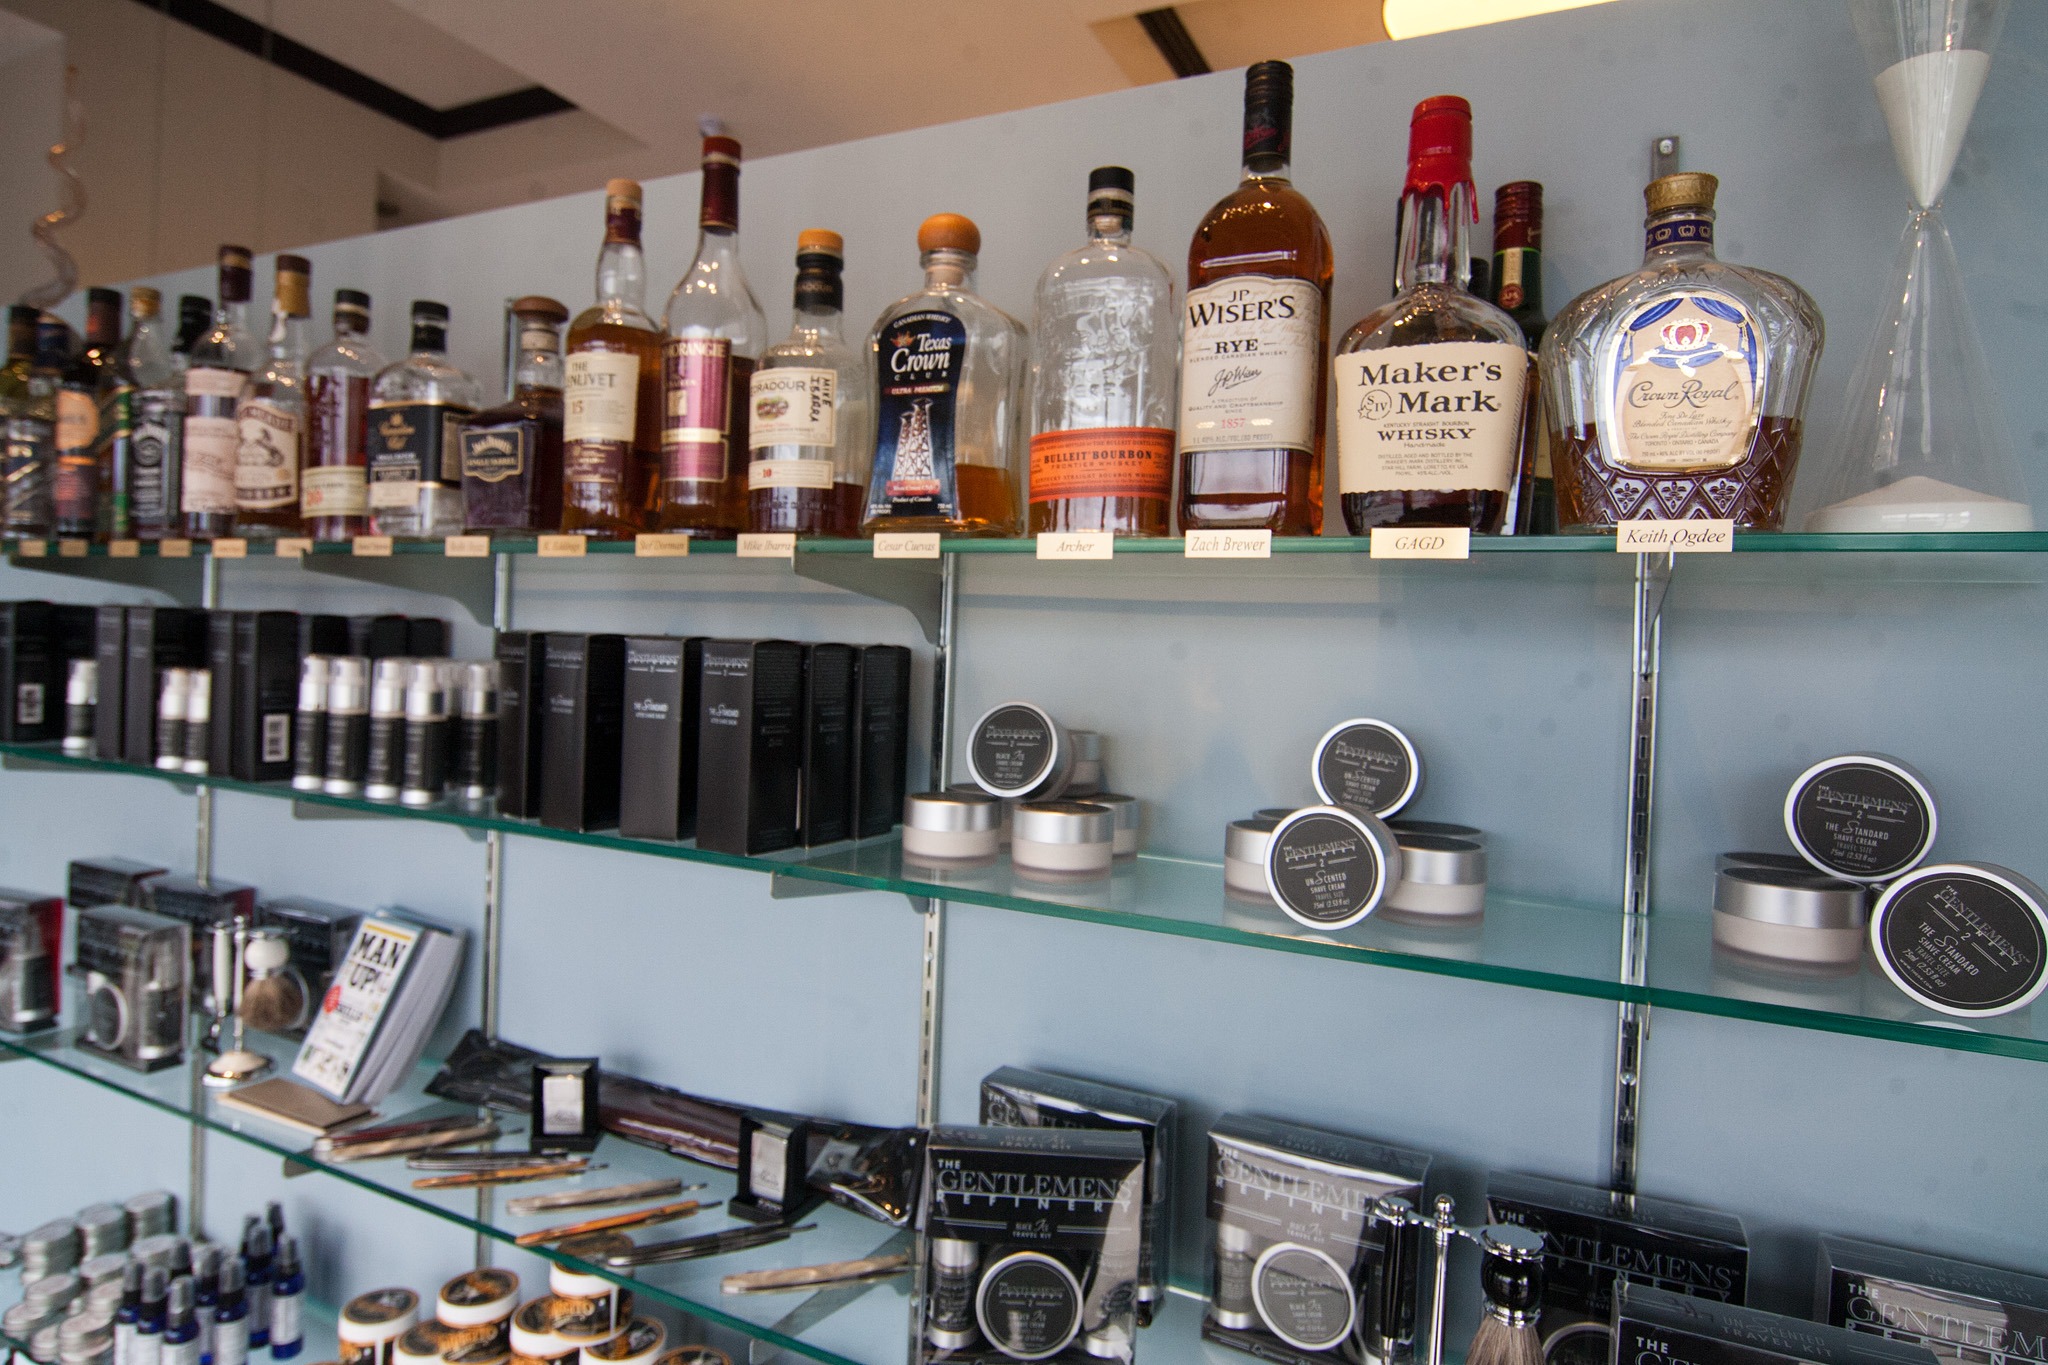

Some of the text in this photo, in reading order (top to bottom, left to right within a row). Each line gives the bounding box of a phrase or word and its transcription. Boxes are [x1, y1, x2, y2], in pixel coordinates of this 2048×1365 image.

[1228, 290, 1250, 302] JP
[1189, 295, 1295, 328] WISER'S
[917, 333, 952, 352] Texas
[1215, 339, 1259, 354] RYE
[891, 348, 950, 373] Crown
[1358, 361, 1502, 387] Maker's
[822, 378, 832, 408] MIKE
[1628, 380, 1739, 408] Crown Royal
[1396, 390, 1499, 415] Mark
[1221, 418, 1246, 429] 1857
[1377, 428, 1476, 442] WHISKY
[1044, 452, 1088, 464] BULLEIT
[1092, 450, 1152, 460] BOURBON
[878, 540, 936, 552] Cesar Cuevas
[1056, 540, 1095, 552] Archer
[1191, 537, 1266, 551] Zach Brewer
[1395, 536, 1445, 551] GAGD
[1626, 529, 1726, 545] Keith Ogdee
[1818, 789, 1909, 811] GENTLEMENS
[1857, 810, 1862, 819] 2
[1825, 820, 1889, 840] THE STANDARD
[1833, 833, 1877, 847] SHAVE CREAM
[1320, 859, 1325, 867] 2
[1305, 870, 1347, 886] UNSCENTED
[1310, 882, 1345, 894] SHAVE CREAM
[1940, 889, 2027, 964] GENTLEMENS
[1961, 932, 1971, 941] 2
[353, 932, 406, 969] MAN
[1918, 922, 1936, 937] THE
[1934, 936, 1979, 976] STANDARD
[1918, 936, 1941, 957] SHAVE
[1939, 953, 1961, 975] CREAM
[1915, 946, 1934, 967] TRAVEL
[1934, 964, 1950, 978] SIZE
[1218, 1146, 1239, 1159] THE
[937, 1159, 961, 1169] THE
[936, 1169, 1132, 1200] GENTLEMENS
[1218, 1157, 1394, 1217] GENTLEMEN
[936, 1191, 1131, 1213] REFINERY
[1215, 1175, 1378, 1229] REFINER
[1499, 1210, 1525, 1223] THE
[1012, 1231, 1038, 1239] TRAVEL
[1544, 1233, 1733, 1290] NTLEMENS
[1848, 1283, 1879, 1299] THE
[1723, 1316, 1825, 1346] UNSCENTED
[1636, 1336, 1669, 1354] THE
[1723, 1327, 1832, 1358] TRAVEL KIT
